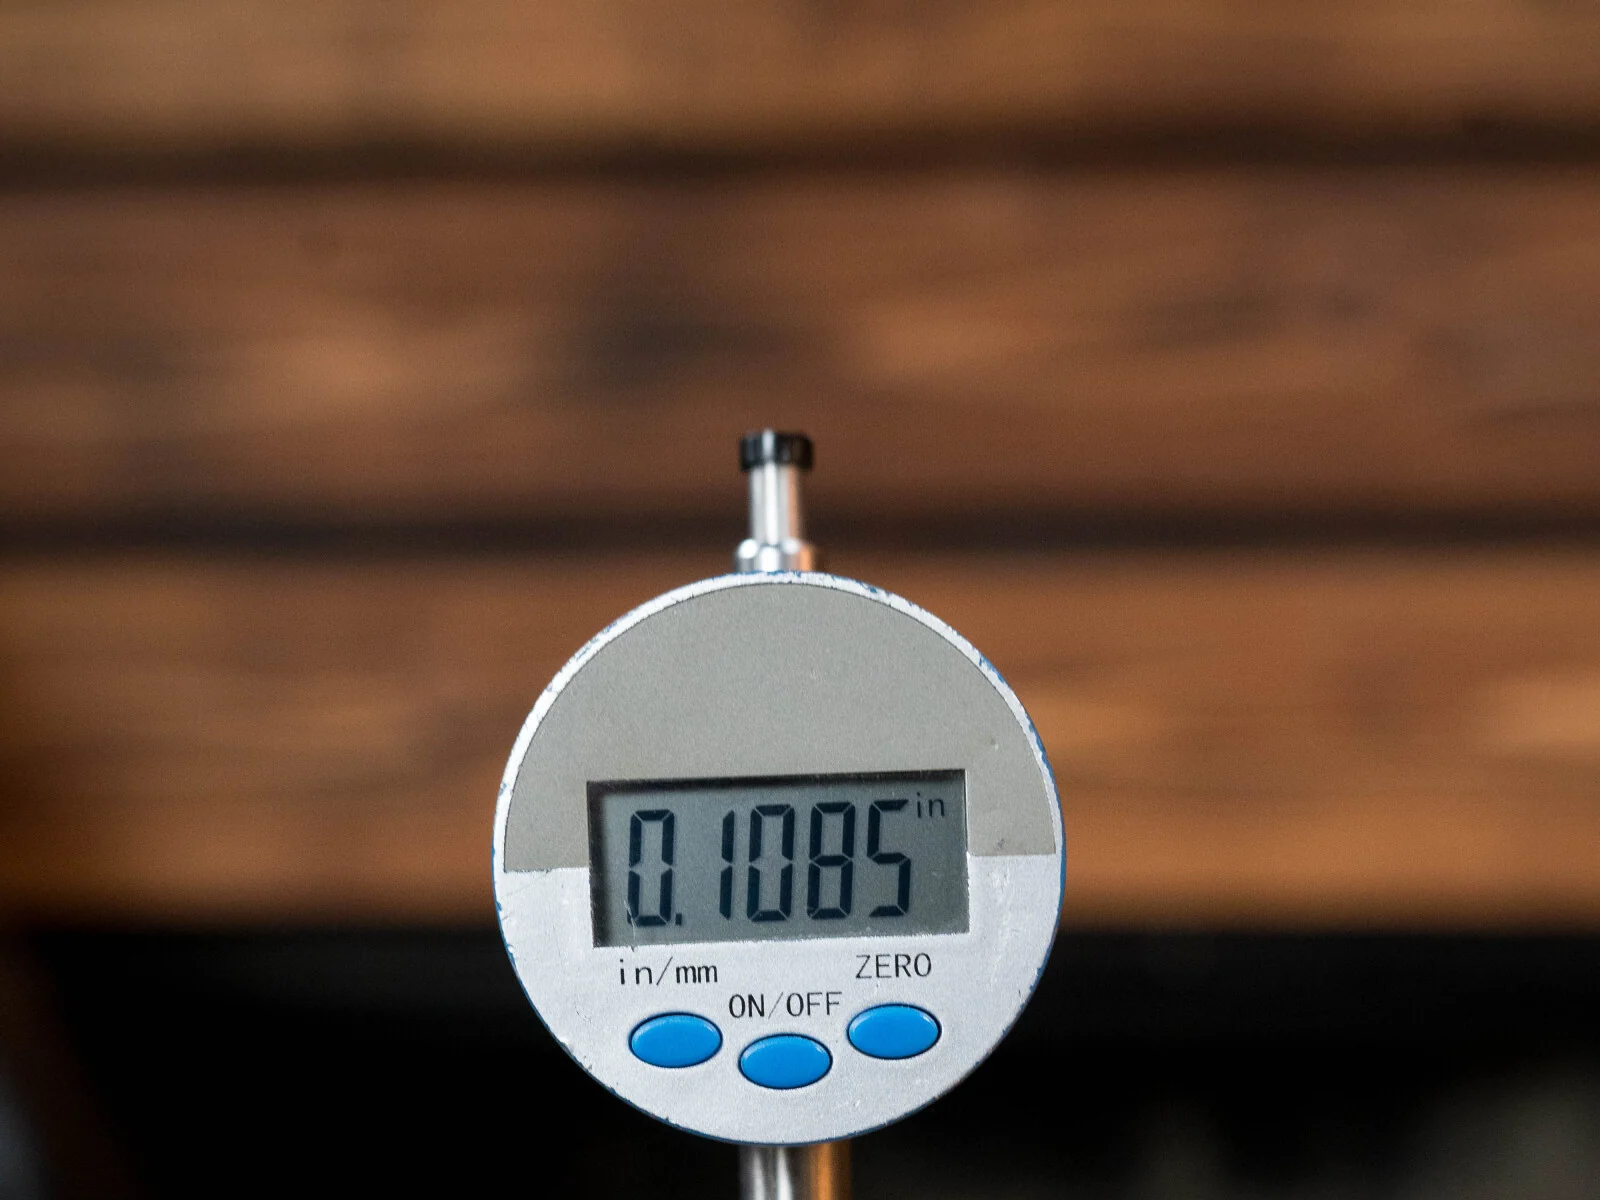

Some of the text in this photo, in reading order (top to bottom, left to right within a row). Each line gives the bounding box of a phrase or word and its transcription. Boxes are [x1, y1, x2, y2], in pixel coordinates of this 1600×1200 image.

[627, 791, 945, 927] 0.1085 in
[619, 956, 719, 986] in/mm
[855, 952, 933, 980] ZERO
[728, 991, 843, 1019] ON/OFF
